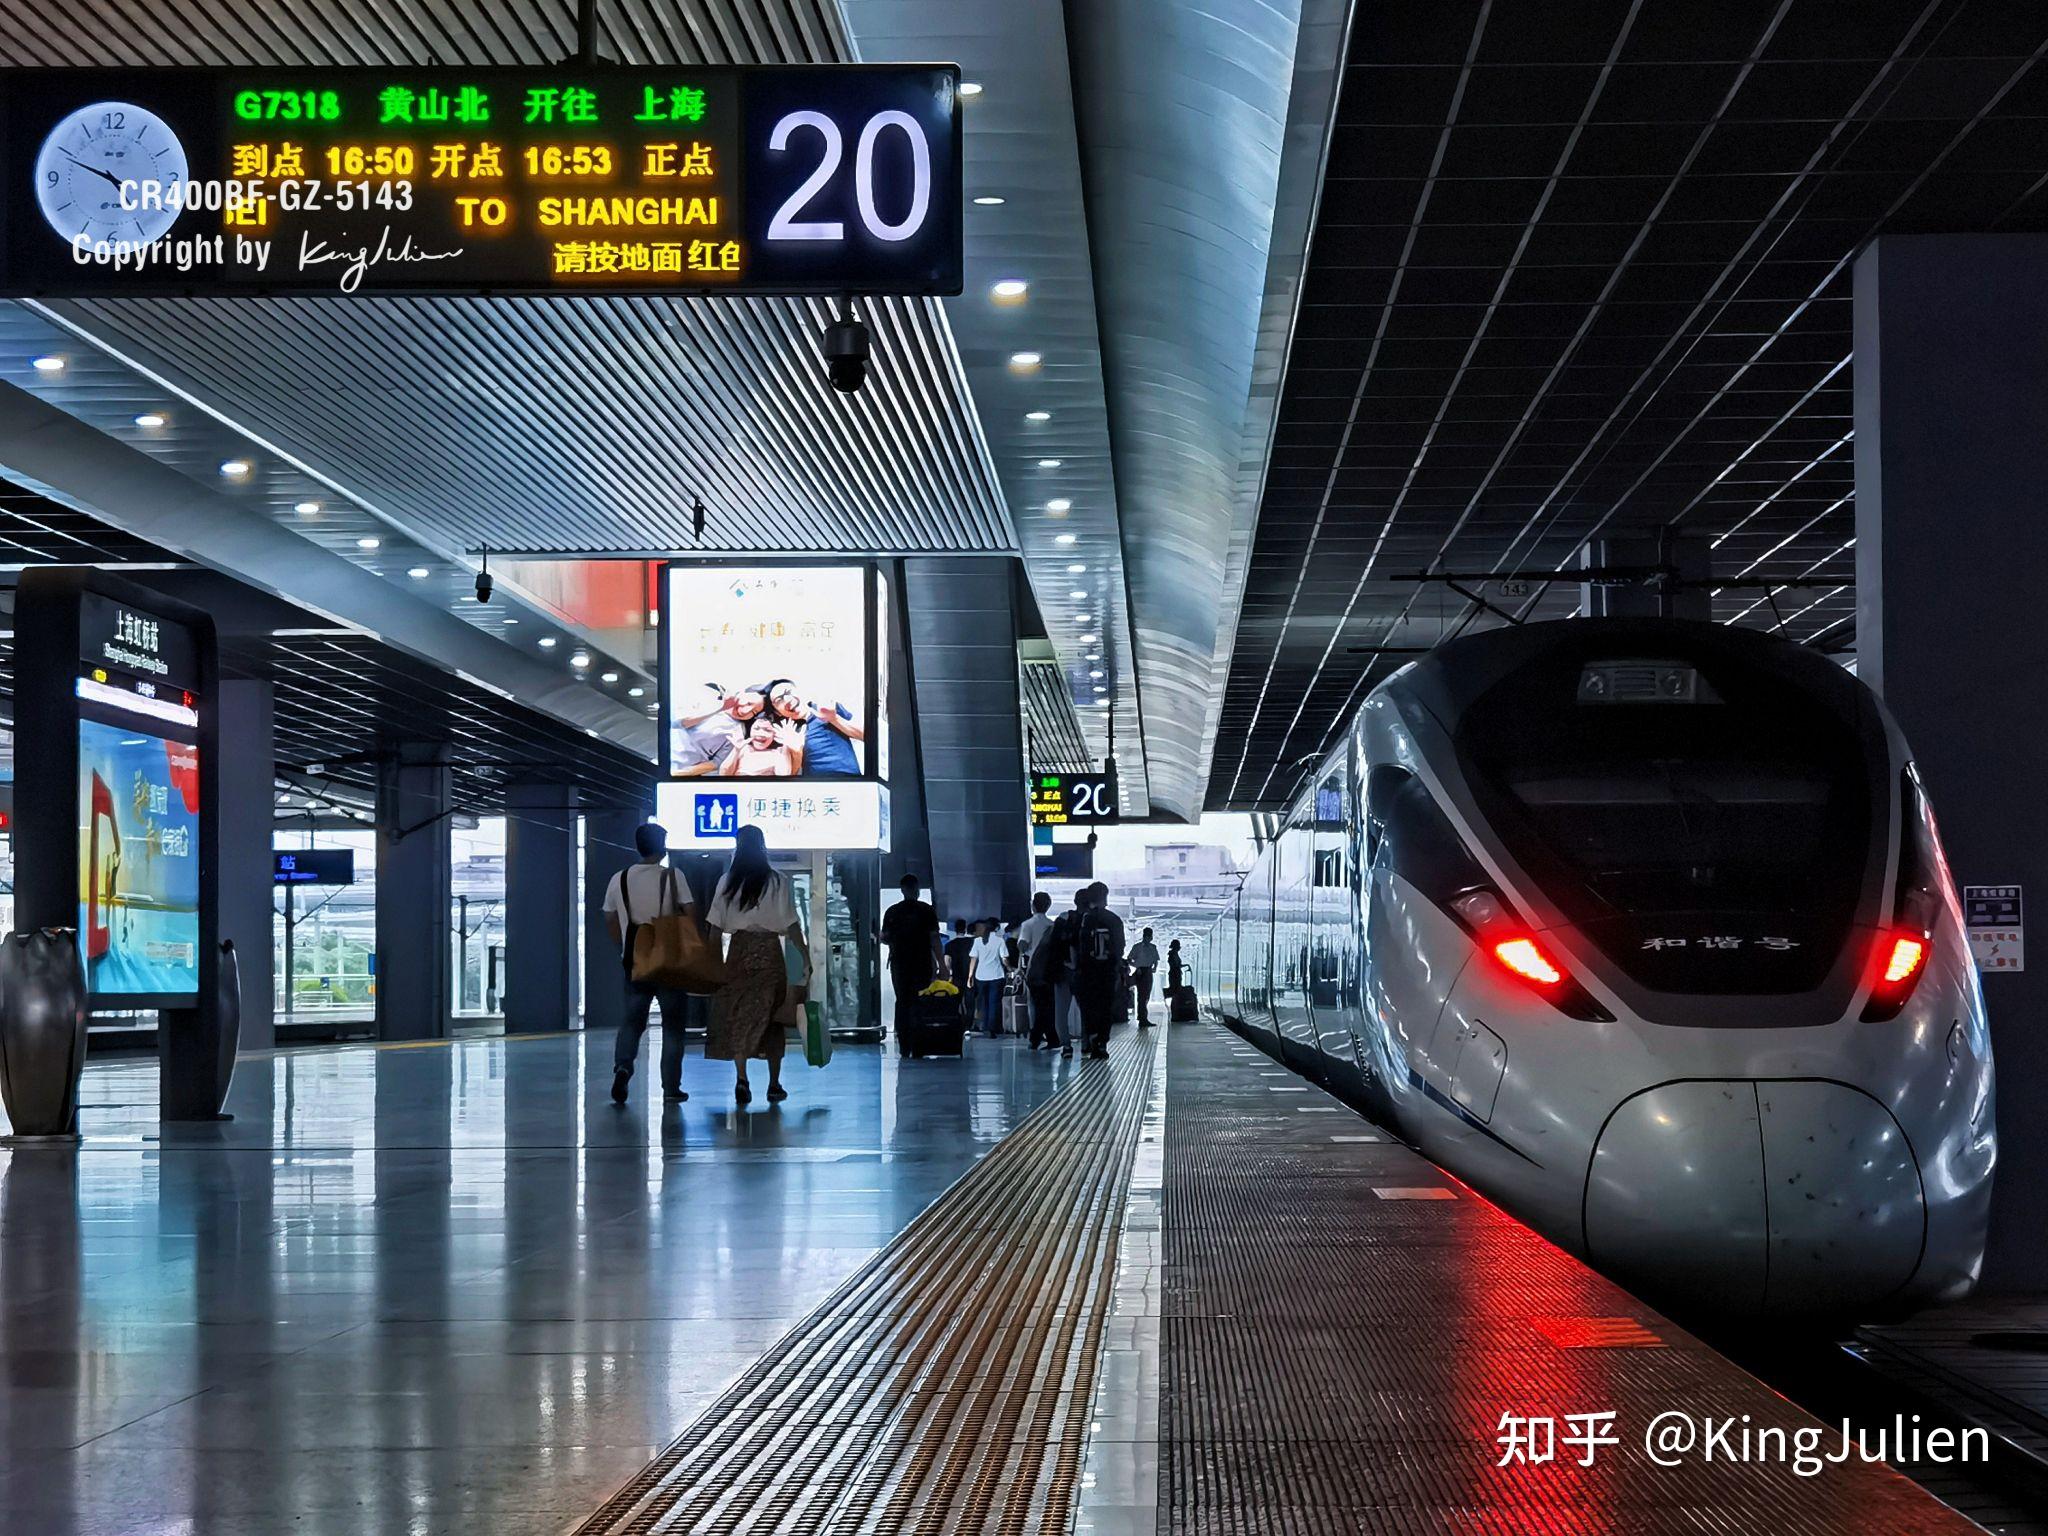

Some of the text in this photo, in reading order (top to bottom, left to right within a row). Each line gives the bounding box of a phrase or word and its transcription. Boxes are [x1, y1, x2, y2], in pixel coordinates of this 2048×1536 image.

[235, 86, 707, 123] G7318 黄山北 开往 上海
[105, 112, 125, 130] 12
[232, 142, 714, 178] 到点 16:50 开点 16:53 正点
[48, 171, 59, 188] 9
[768, 111, 931, 242] 20
[456, 198, 508, 226] TO
[539, 197, 718, 225] SHANGHAI
[1641, 936, 1801, 951] 和谐号
